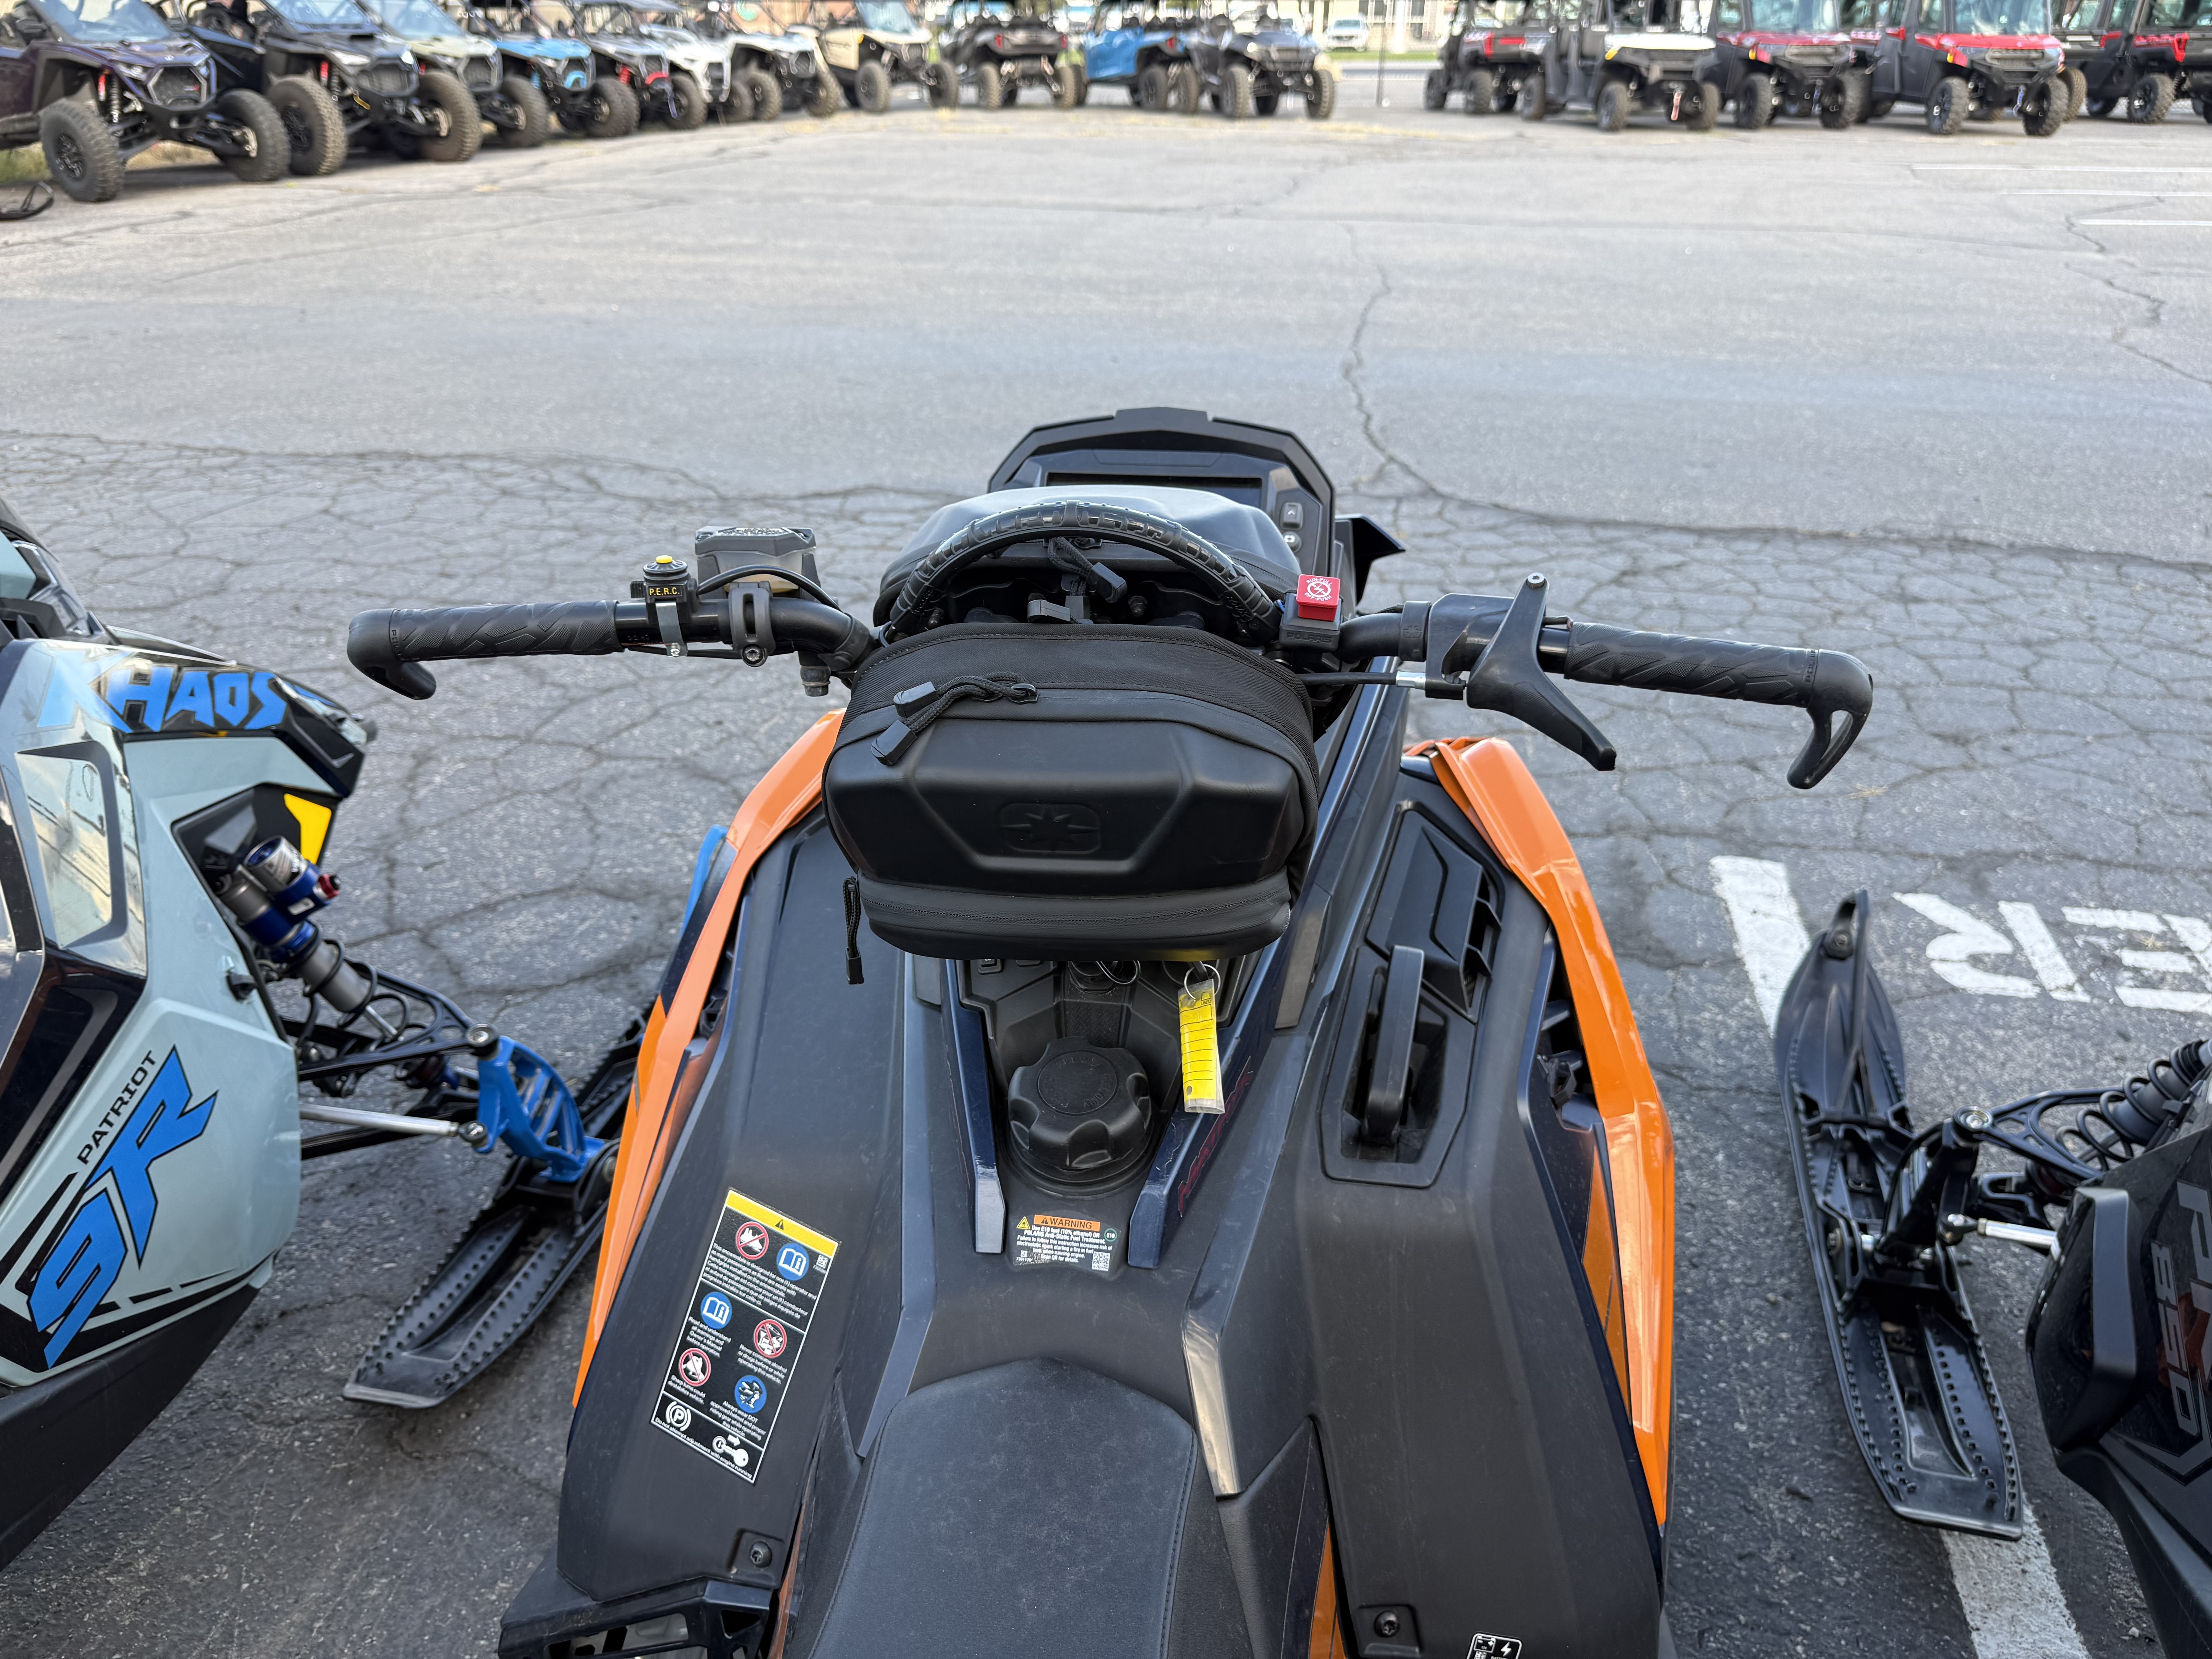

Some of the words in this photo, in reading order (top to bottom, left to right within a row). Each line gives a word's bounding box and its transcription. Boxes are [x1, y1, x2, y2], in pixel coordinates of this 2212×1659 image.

[649, 587, 680, 596] P.E.R.C.
[1286, 631, 1333, 644] POLARIS
[38, 650, 288, 734] KHAOS
[76, 1049, 156, 1165] PATRIOT
[1049, 1218, 1092, 1229] WARNING
[1016, 1240, 1041, 1248] electrostatic
[1024, 1229, 1044, 1237] POLARIS
[1044, 1231, 1070, 1240] Anti-Static
[1081, 1235, 1106, 1244] Treatment.
[2151, 1240, 2202, 1437] 850
[654, 1416, 663, 1425] Do
[661, 1420, 670, 1430] not
[669, 1425, 687, 1440] attempt
[685, 1435, 711, 1454] adjustment
[710, 1449, 721, 1460] with
[719, 1455, 736, 1468] engine
[734, 1463, 752, 1479] running
